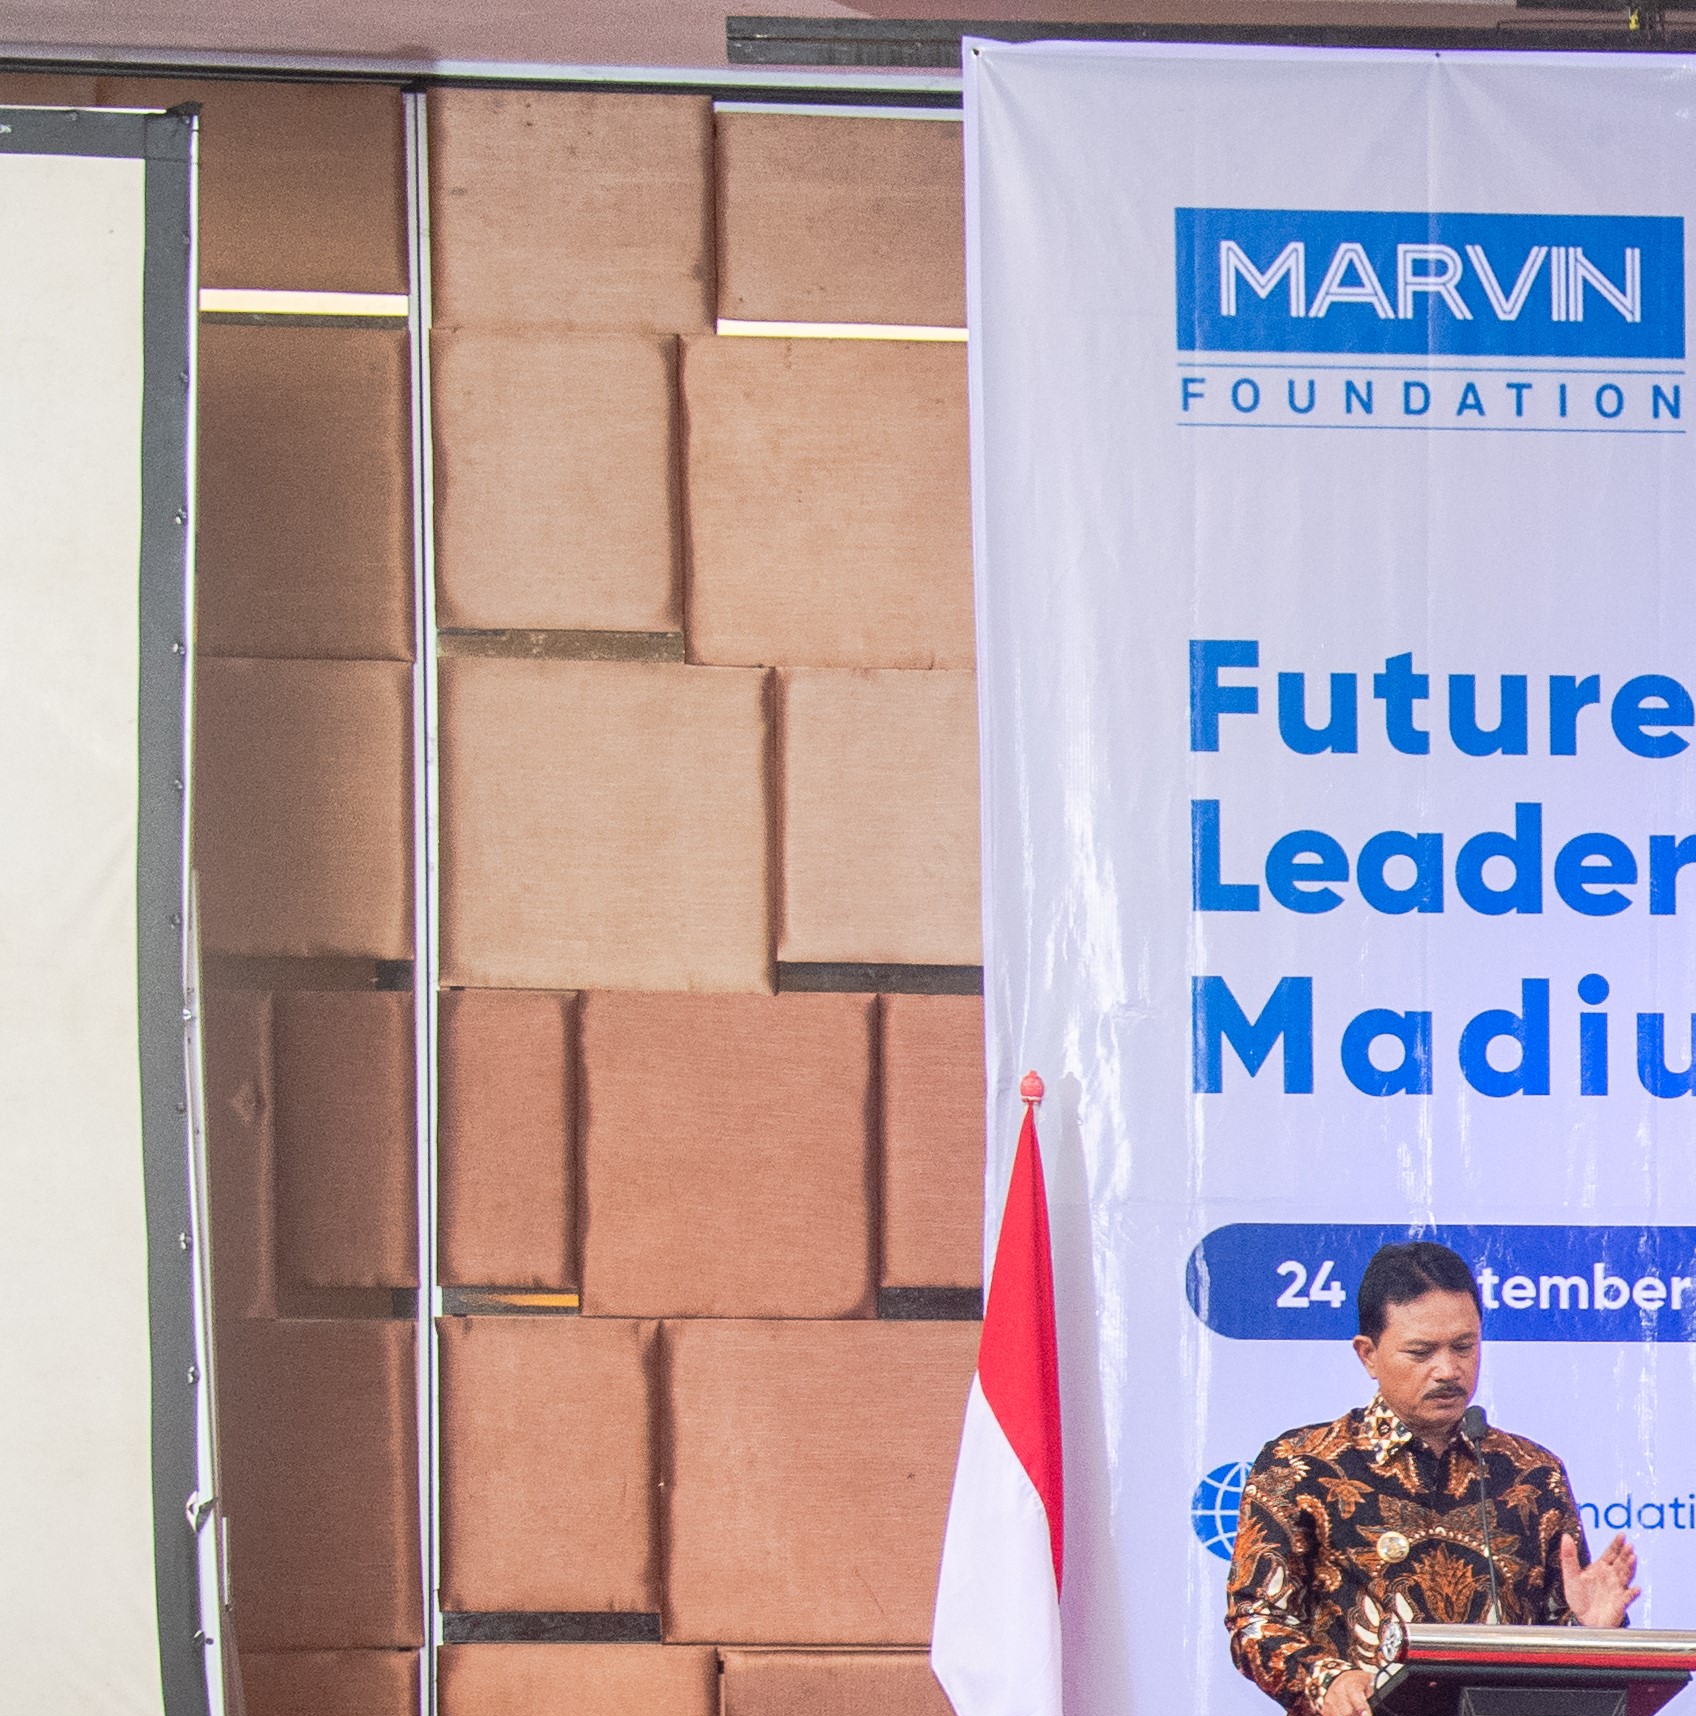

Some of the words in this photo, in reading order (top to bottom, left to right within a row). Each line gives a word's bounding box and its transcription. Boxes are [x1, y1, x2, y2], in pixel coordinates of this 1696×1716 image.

[1219, 241, 1641, 325] MARVIN
[1179, 378, 1684, 422] FOUNDATION
[1188, 639, 1696, 760] Future
[1275, 1260, 1346, 1309] 24
[1479, 1263, 1692, 1311] tember
